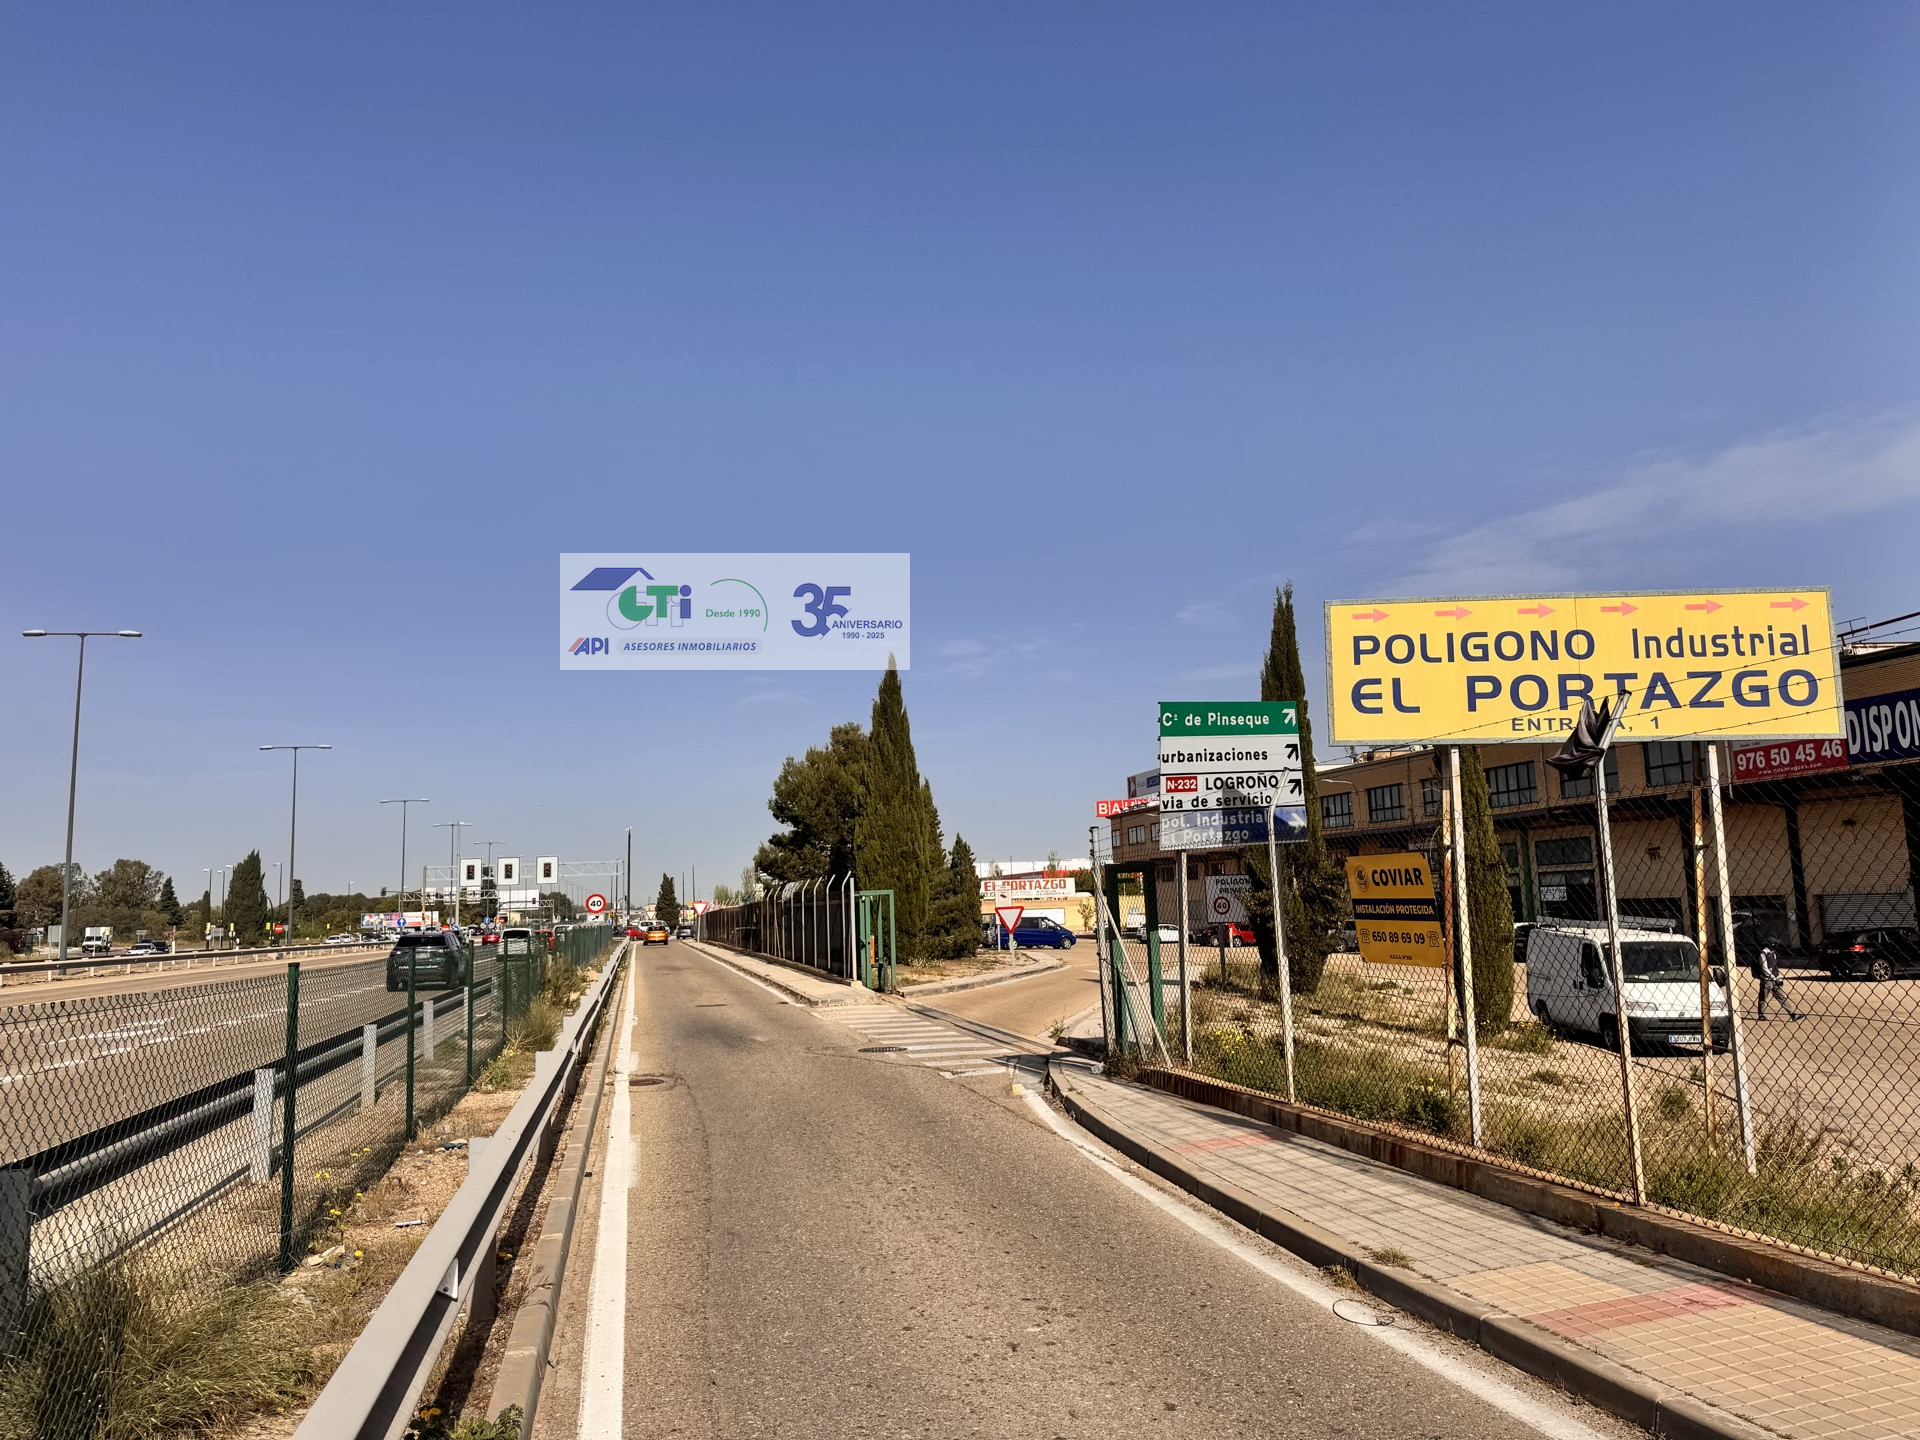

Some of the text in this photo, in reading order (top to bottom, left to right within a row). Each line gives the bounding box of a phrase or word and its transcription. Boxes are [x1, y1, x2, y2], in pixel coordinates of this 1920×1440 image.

[1353, 624, 1810, 666] POLIGONO Industrial
[1352, 669, 1819, 714] EL PORTAZGO
[1185, 714, 1202, 726] de
[1208, 712, 1270, 728] Pinseque
[1512, 716, 1659, 732] ENTRA, 1
[1162, 748, 1268, 764] urbanizaciones
[1736, 740, 1842, 770] 976 50 45 46
[1166, 779, 1197, 790] N-232
[1206, 773, 1279, 790] LOGROÑO
[1162, 796, 1184, 810] via
[1191, 796, 1208, 808] de
[1216, 793, 1272, 807] servicio
[1162, 810, 1268, 830] pol. industrial
[1184, 828, 1249, 844] Portazgo
[1216, 878, 1251, 886] POLÍGON
[1372, 868, 1424, 886] COVIAR
[1356, 902, 1434, 915] INSTALACIÓN PROTEGIDA
[1372, 931, 1425, 944] 650 89 69 09
